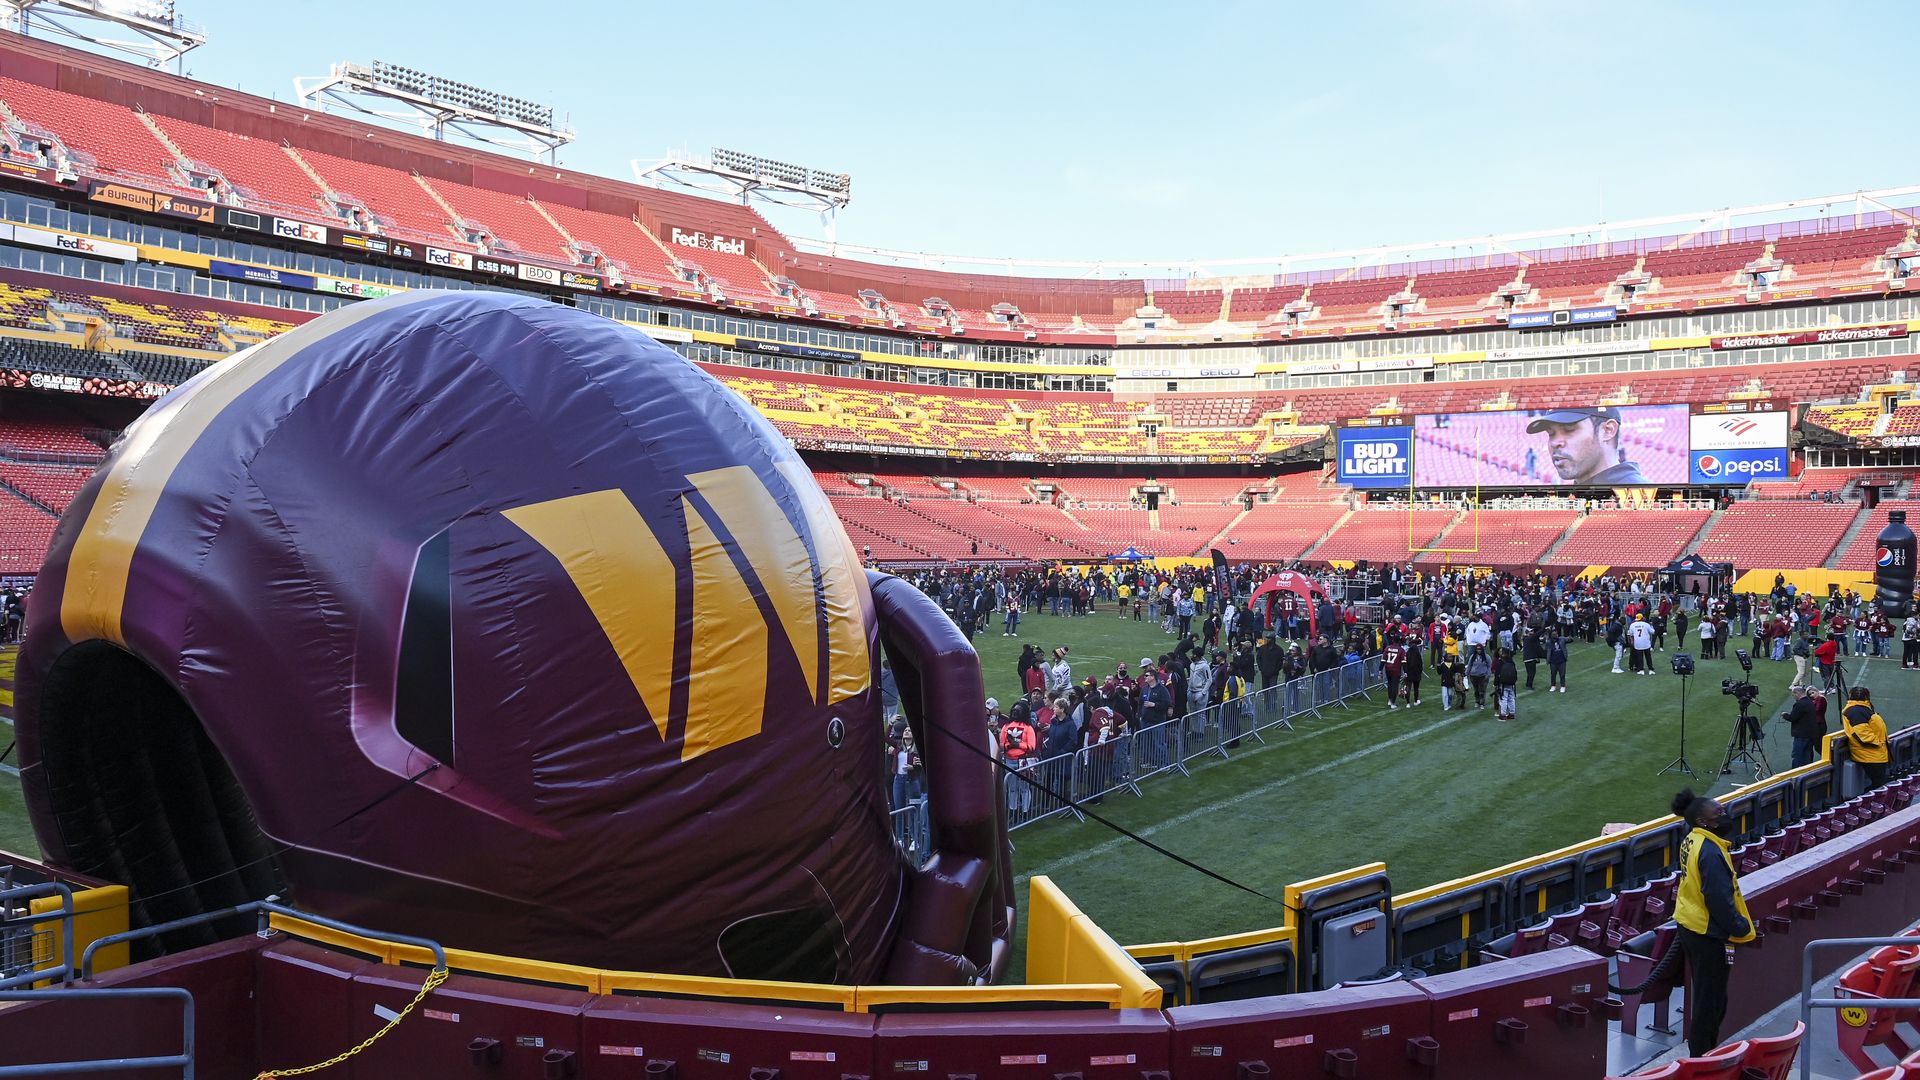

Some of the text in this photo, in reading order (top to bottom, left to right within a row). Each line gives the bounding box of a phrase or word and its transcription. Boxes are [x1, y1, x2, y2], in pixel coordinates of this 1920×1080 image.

[107, 189, 199, 215] BURGUNDY & GOLD
[276, 219, 319, 240] FedEx
[57, 234, 94, 252] FedEx
[672, 227, 745, 256] FedExField
[429, 250, 466, 267] FedEx
[500, 265, 515, 276] PM
[529, 266, 553, 280] BDO
[574, 274, 599, 286] Sports
[1818, 327, 1896, 342] ticketmaster
[758, 342, 779, 352] Acronis
[1721, 335, 1795, 348] ticketmaster
[1200, 367, 1240, 376] GEICO
[1302, 363, 1331, 372] SAFEWAY
[1374, 361, 1405, 370] SAFEWAY
[1132, 369, 1172, 378] GEICO
[43, 375, 82, 385] BLACK RIFLE
[143, 385, 167, 396] ENJOY
[1353, 443, 1398, 459] BUD
[1345, 458, 1406, 474] LIGHT
[1725, 457, 1779, 475] pepsi
[1284, 602, 1293, 611] 11
[1637, 629, 1642, 637] 7
[1387, 652, 1398, 664] 17
